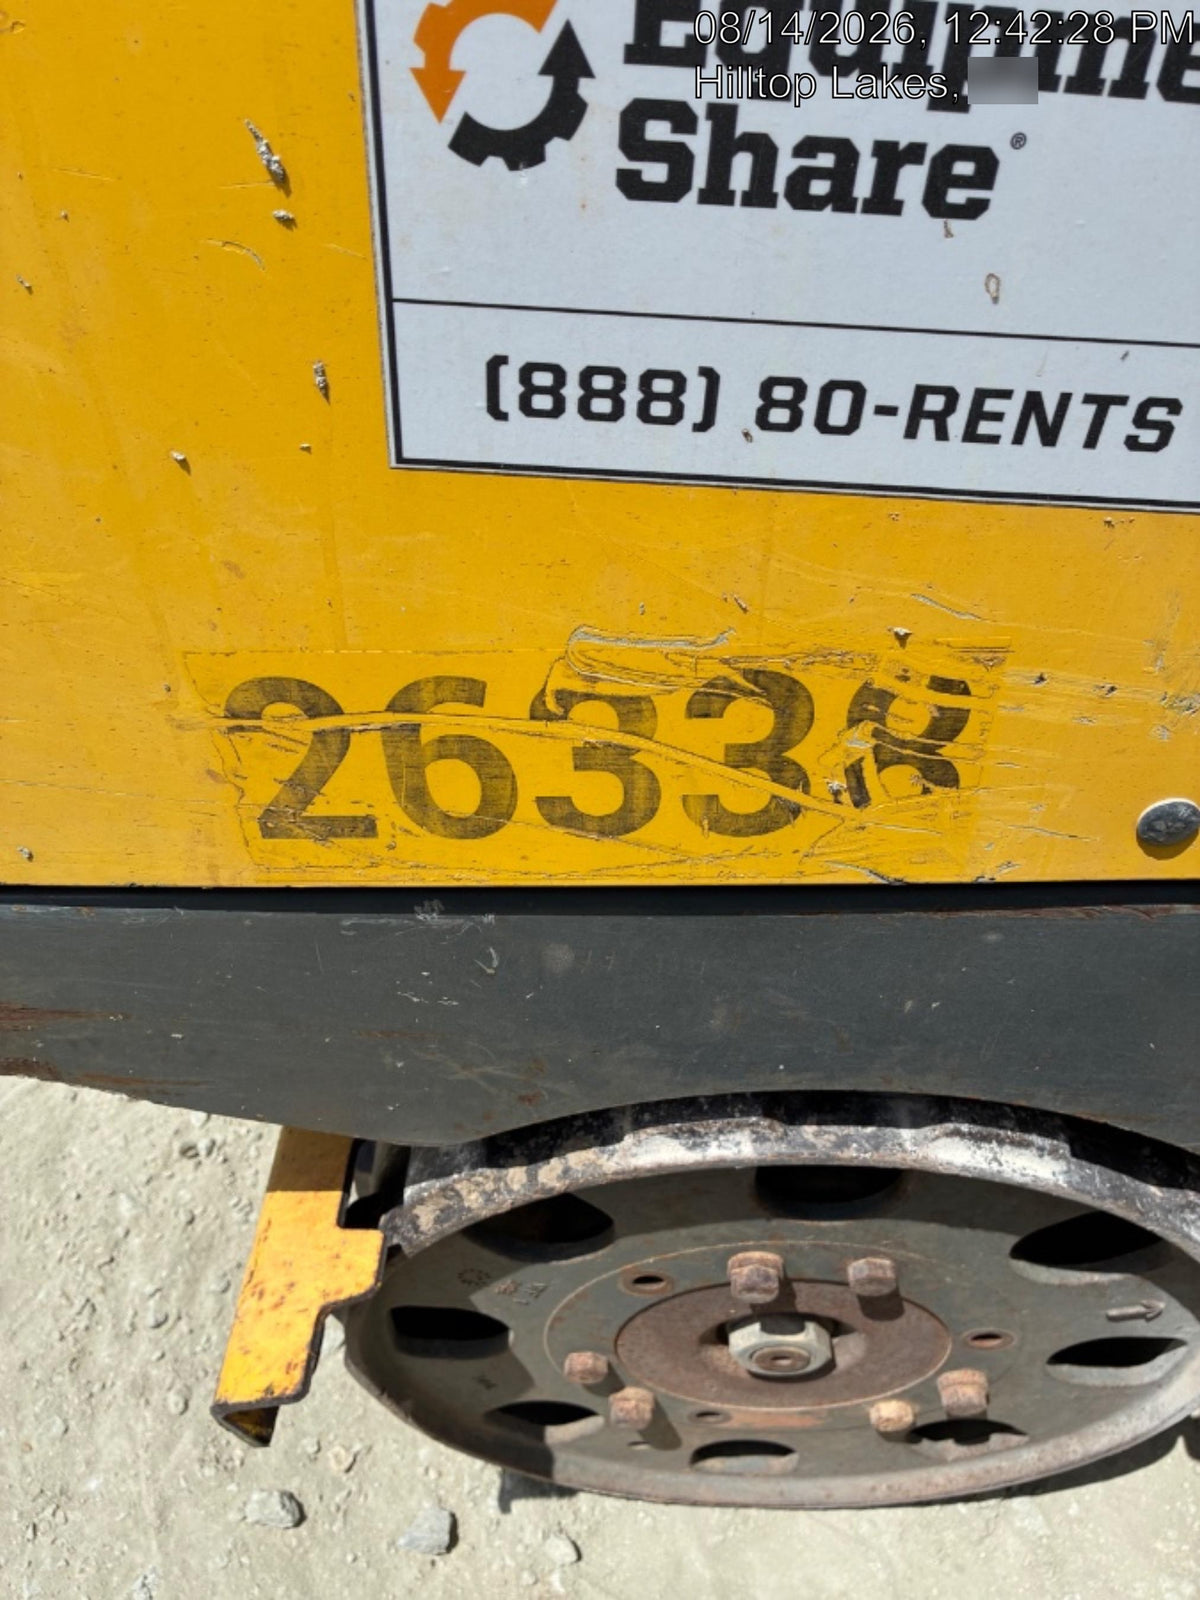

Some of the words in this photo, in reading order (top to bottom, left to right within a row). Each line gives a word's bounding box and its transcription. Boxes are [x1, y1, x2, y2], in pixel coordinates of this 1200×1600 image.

[616, 98, 999, 220] Share
[485, 355, 720, 433] (888)
[754, 376, 1184, 454] 80-RENTS
